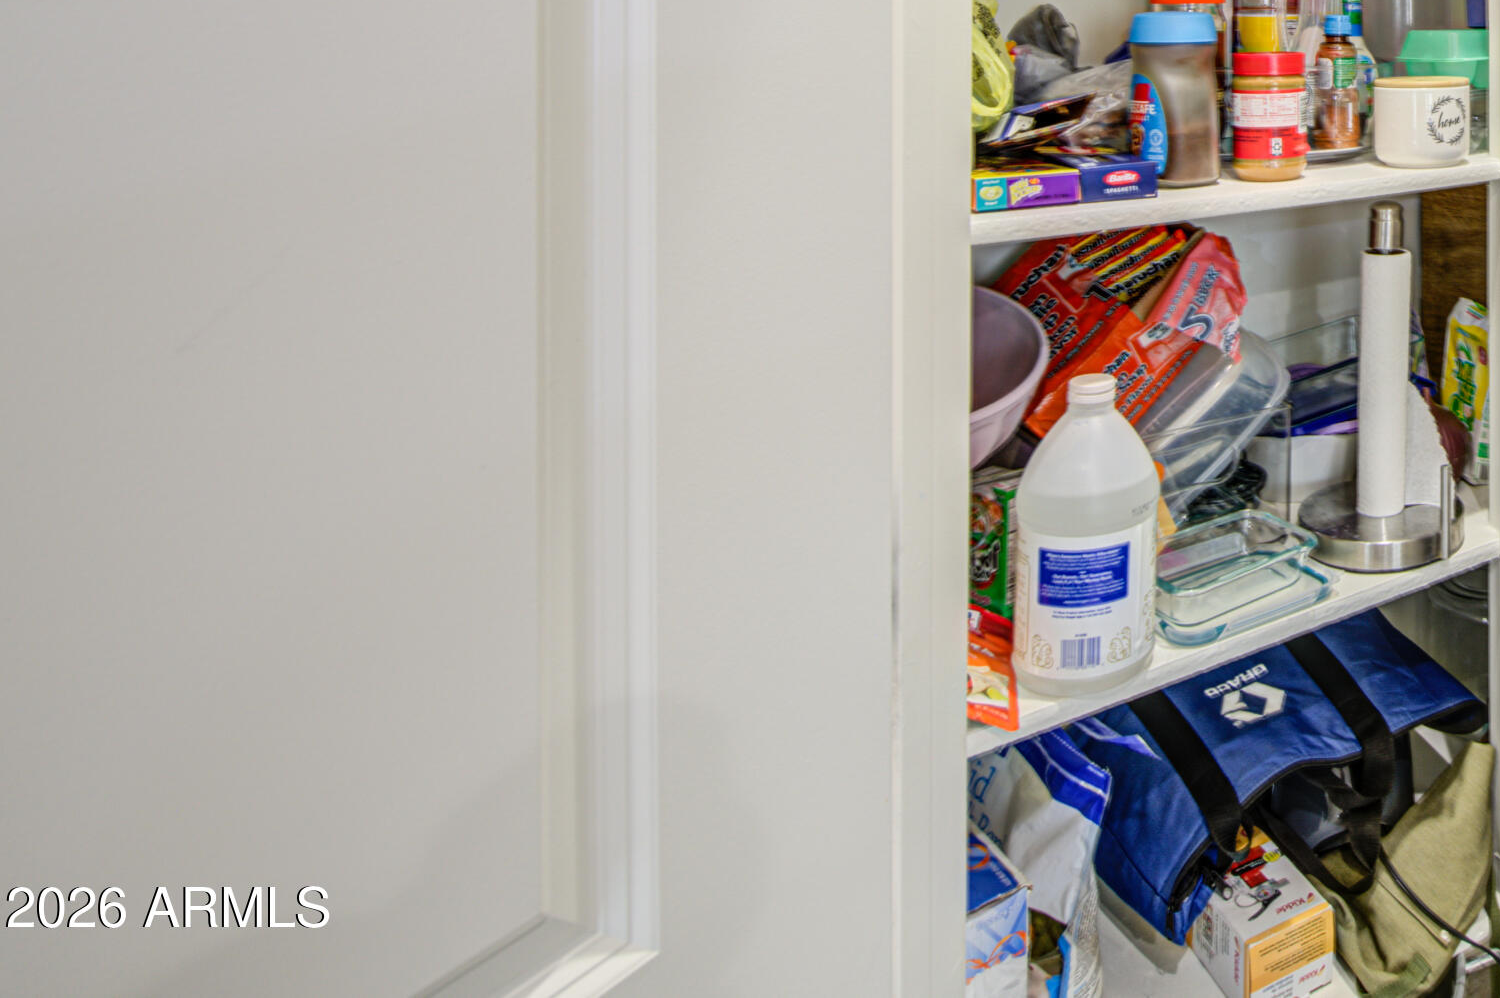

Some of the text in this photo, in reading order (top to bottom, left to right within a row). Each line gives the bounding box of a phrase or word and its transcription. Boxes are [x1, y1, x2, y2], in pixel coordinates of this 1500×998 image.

[1437, 111, 1461, 129] home
[1010, 244, 1067, 301] ruchan
[1108, 251, 1181, 294] Maruchan
[1203, 663, 1269, 699] GRACO
[1275, 897, 1307, 915] Kidde
